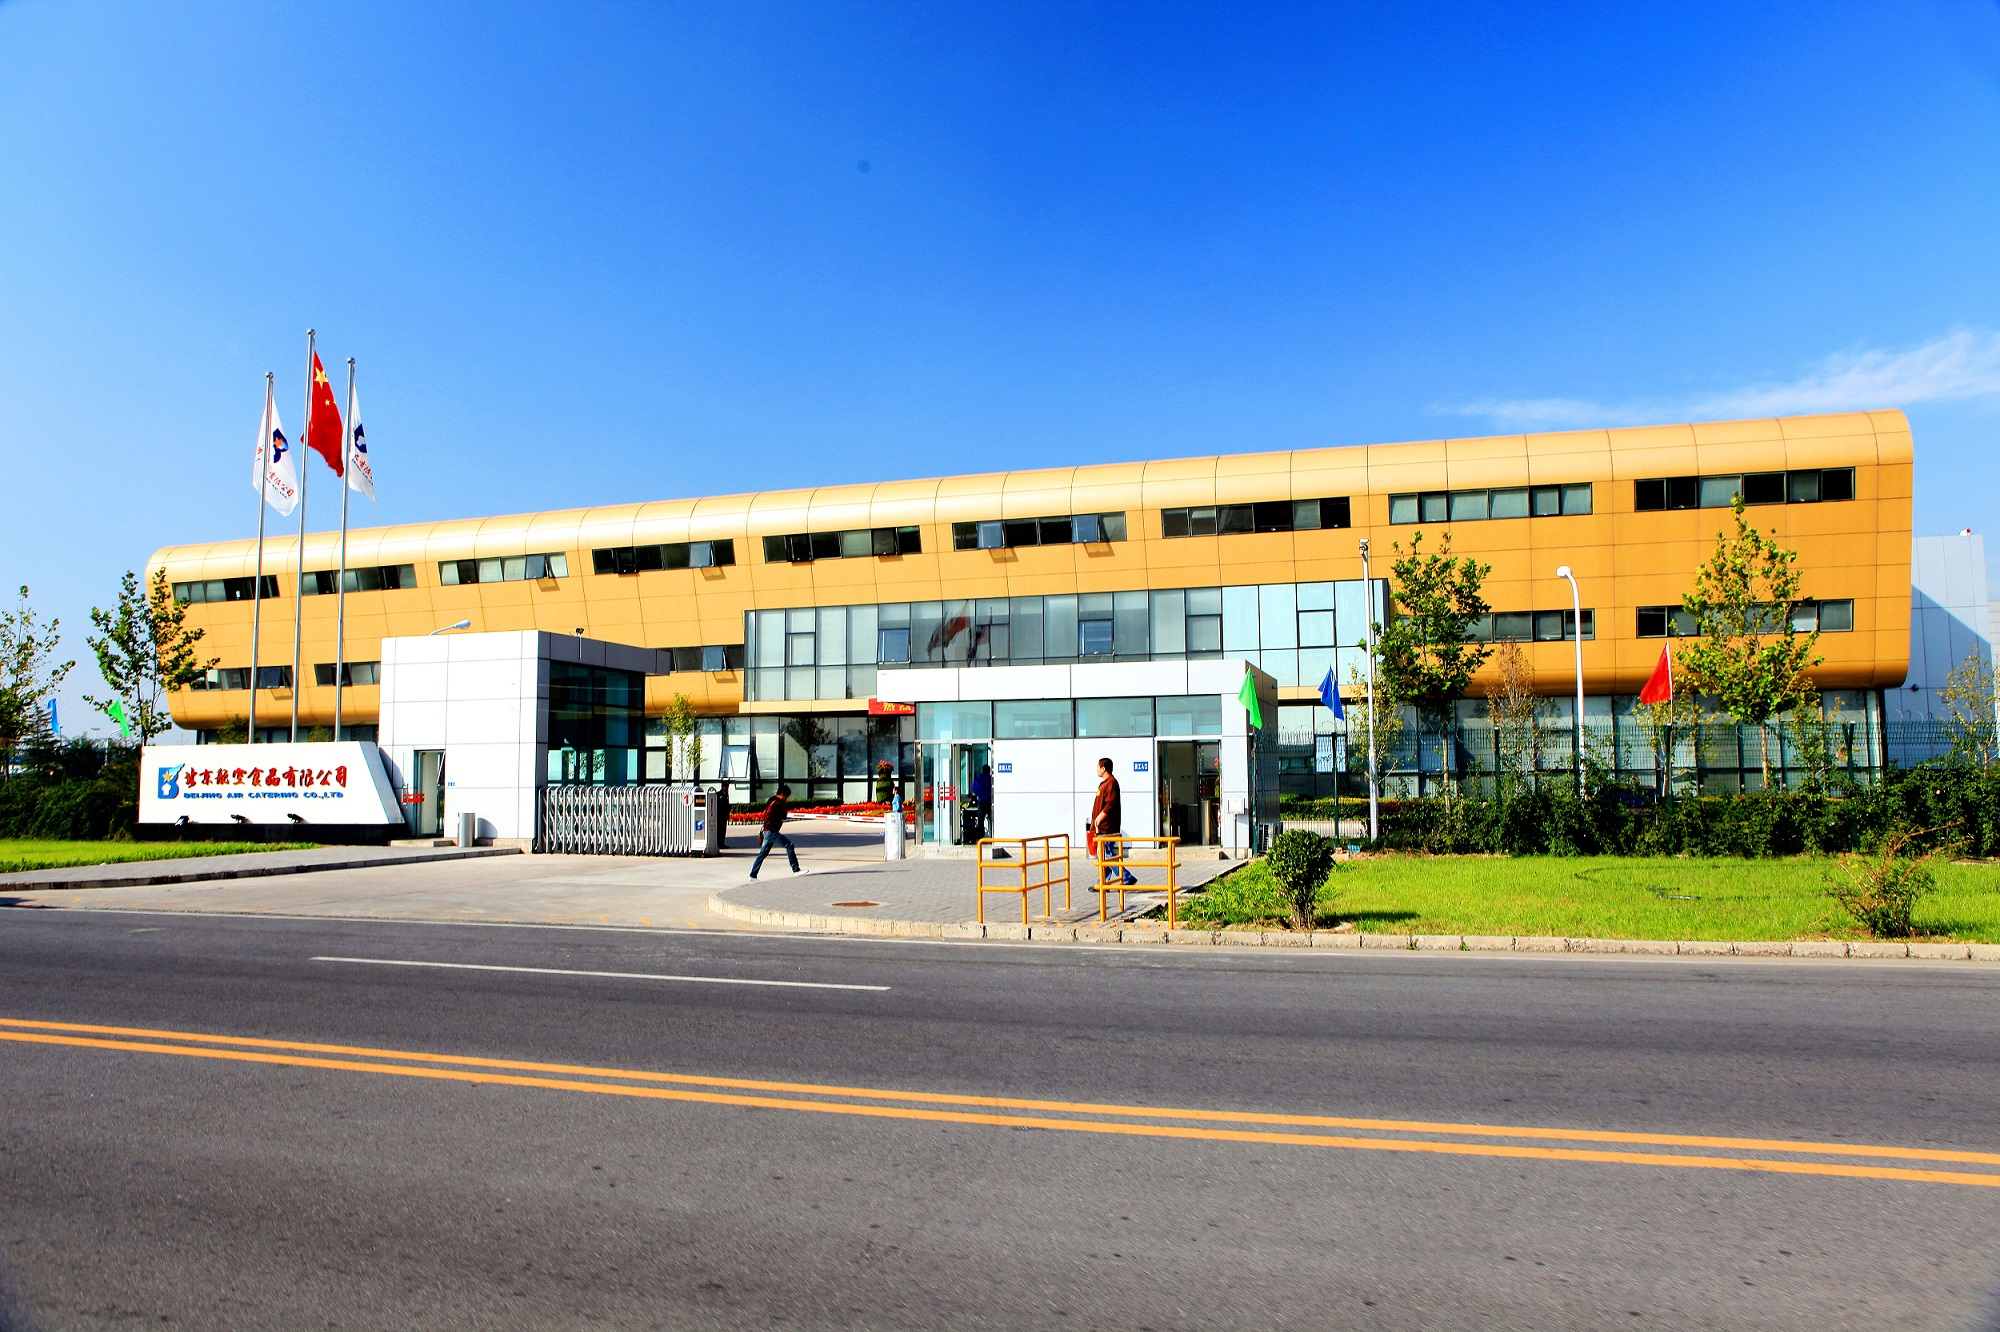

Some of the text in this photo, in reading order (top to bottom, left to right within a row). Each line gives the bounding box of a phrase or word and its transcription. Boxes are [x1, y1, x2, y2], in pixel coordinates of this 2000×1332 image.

[185, 766, 347, 788] 北京航空食品有限公司
[684, 794, 689, 805] 1
